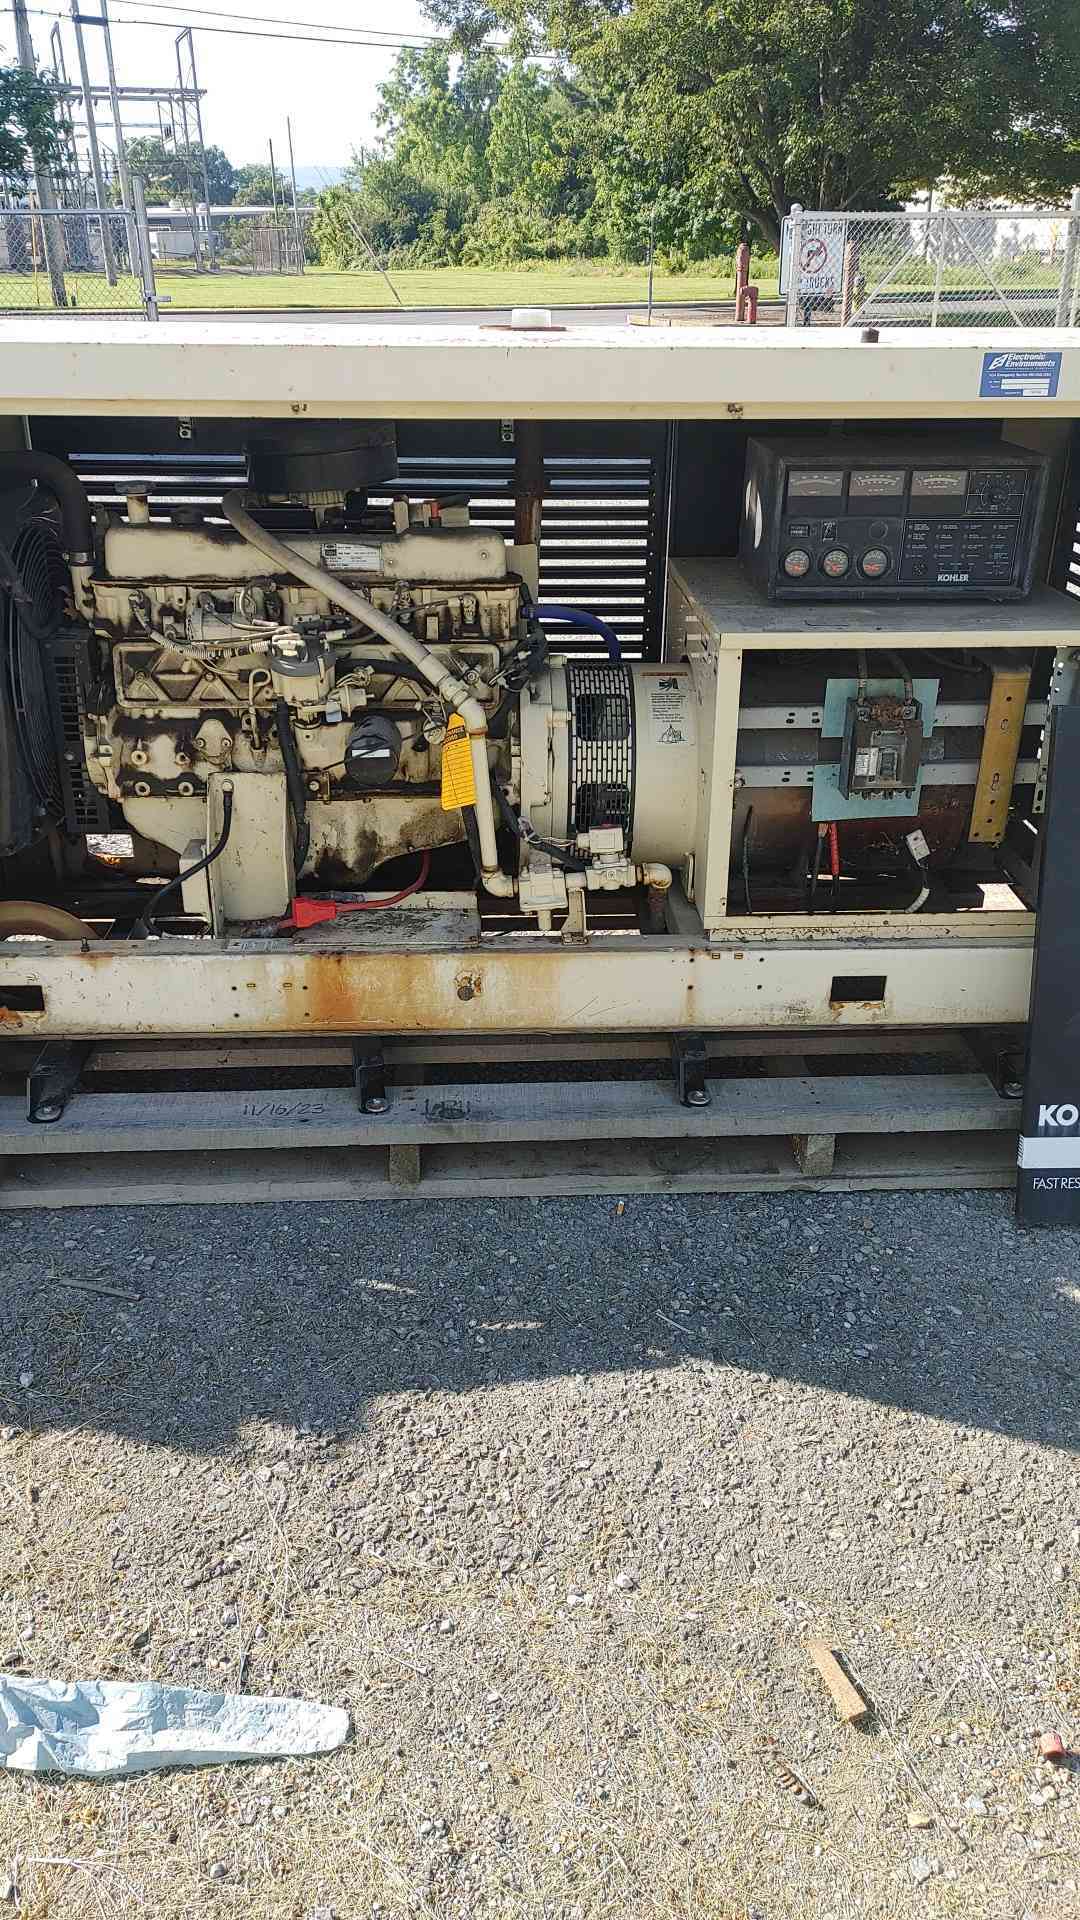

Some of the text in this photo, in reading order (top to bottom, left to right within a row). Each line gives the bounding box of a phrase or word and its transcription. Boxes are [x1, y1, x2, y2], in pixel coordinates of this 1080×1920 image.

[937, 574, 969, 582] KOHLER
[243, 1102, 325, 1116] 11/16/23
[1038, 1104, 1079, 1126] KO
[1033, 1177, 1061, 1189] FAST
